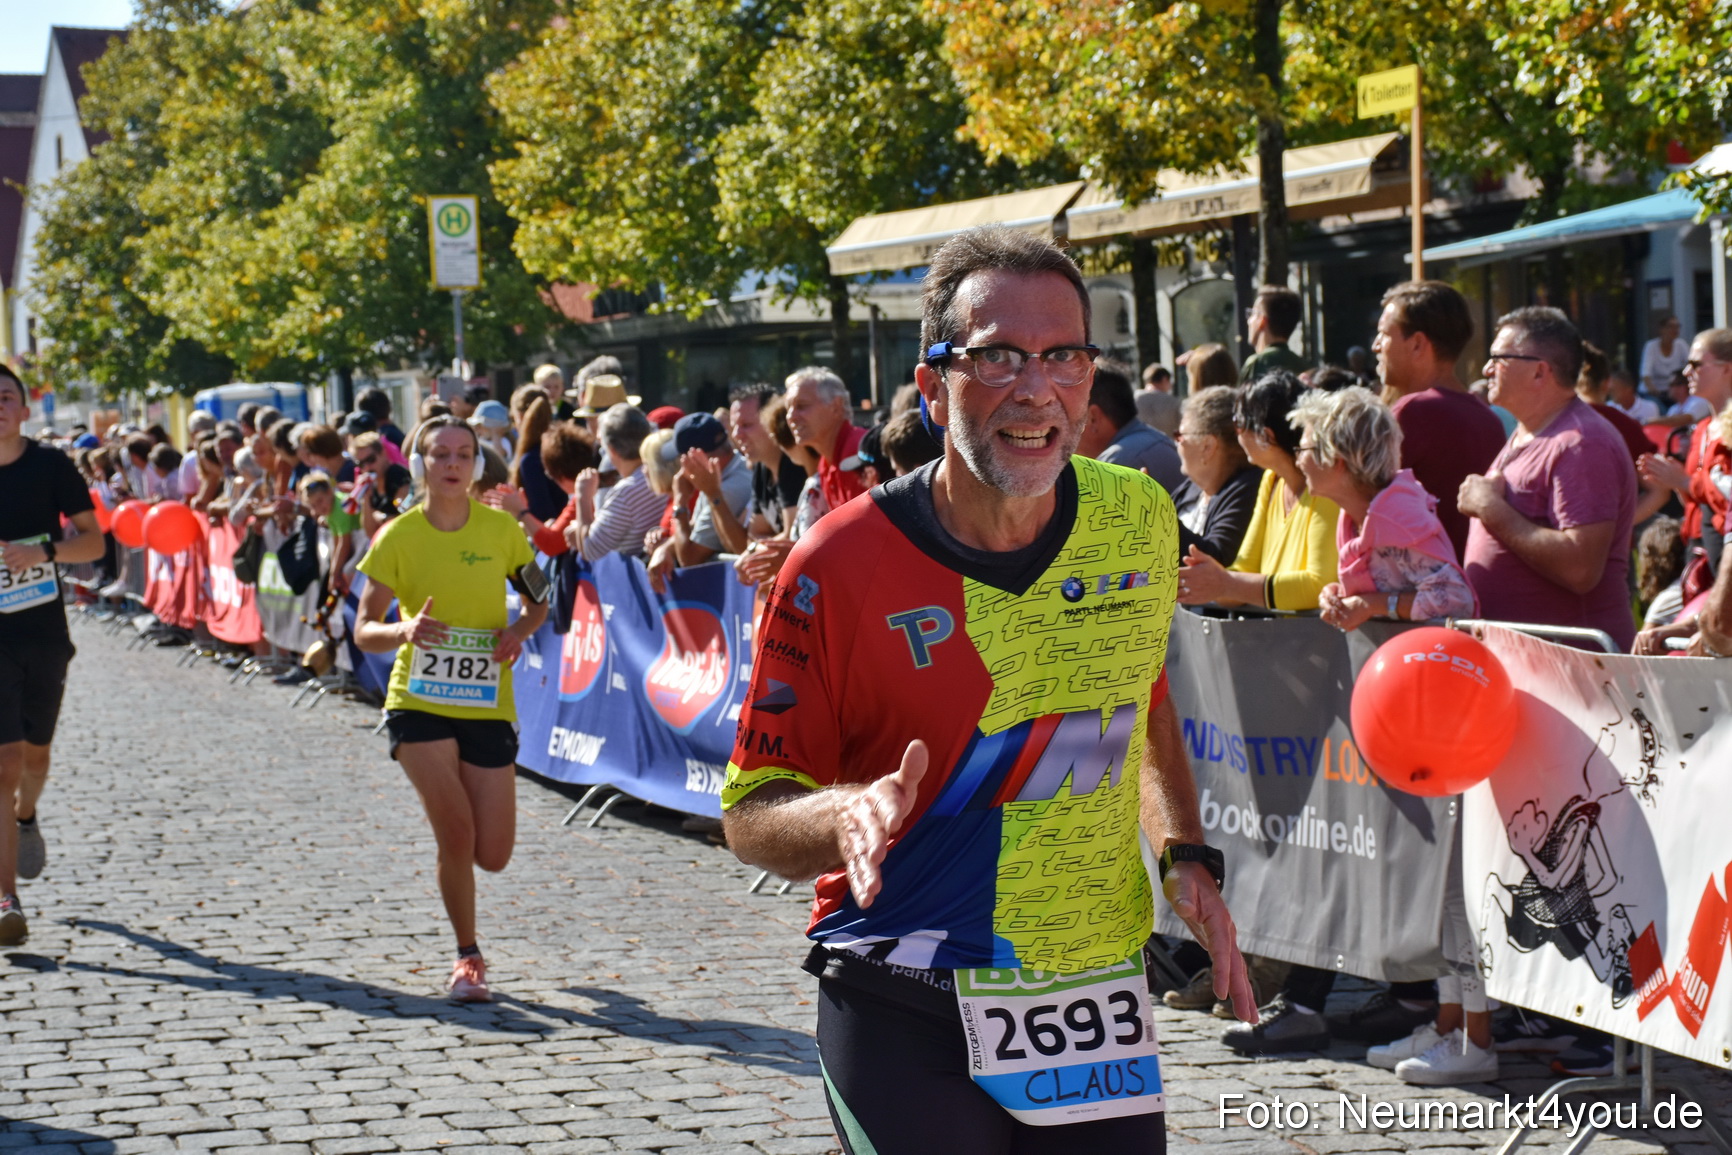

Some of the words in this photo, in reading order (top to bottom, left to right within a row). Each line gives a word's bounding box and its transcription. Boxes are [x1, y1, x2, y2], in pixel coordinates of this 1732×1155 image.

[1370, 83, 1412, 102] Toiletten
[446, 211, 462, 229] H
[1064, 606, 1092, 617] PARTL
[1093, 600, 1136, 613] NEUMARKT
[422, 653, 489, 680] 2182
[423, 683, 483, 699] TATJANA
[984, 990, 1143, 1061] 2693
[1025, 1060, 1145, 1104] CLAUS
